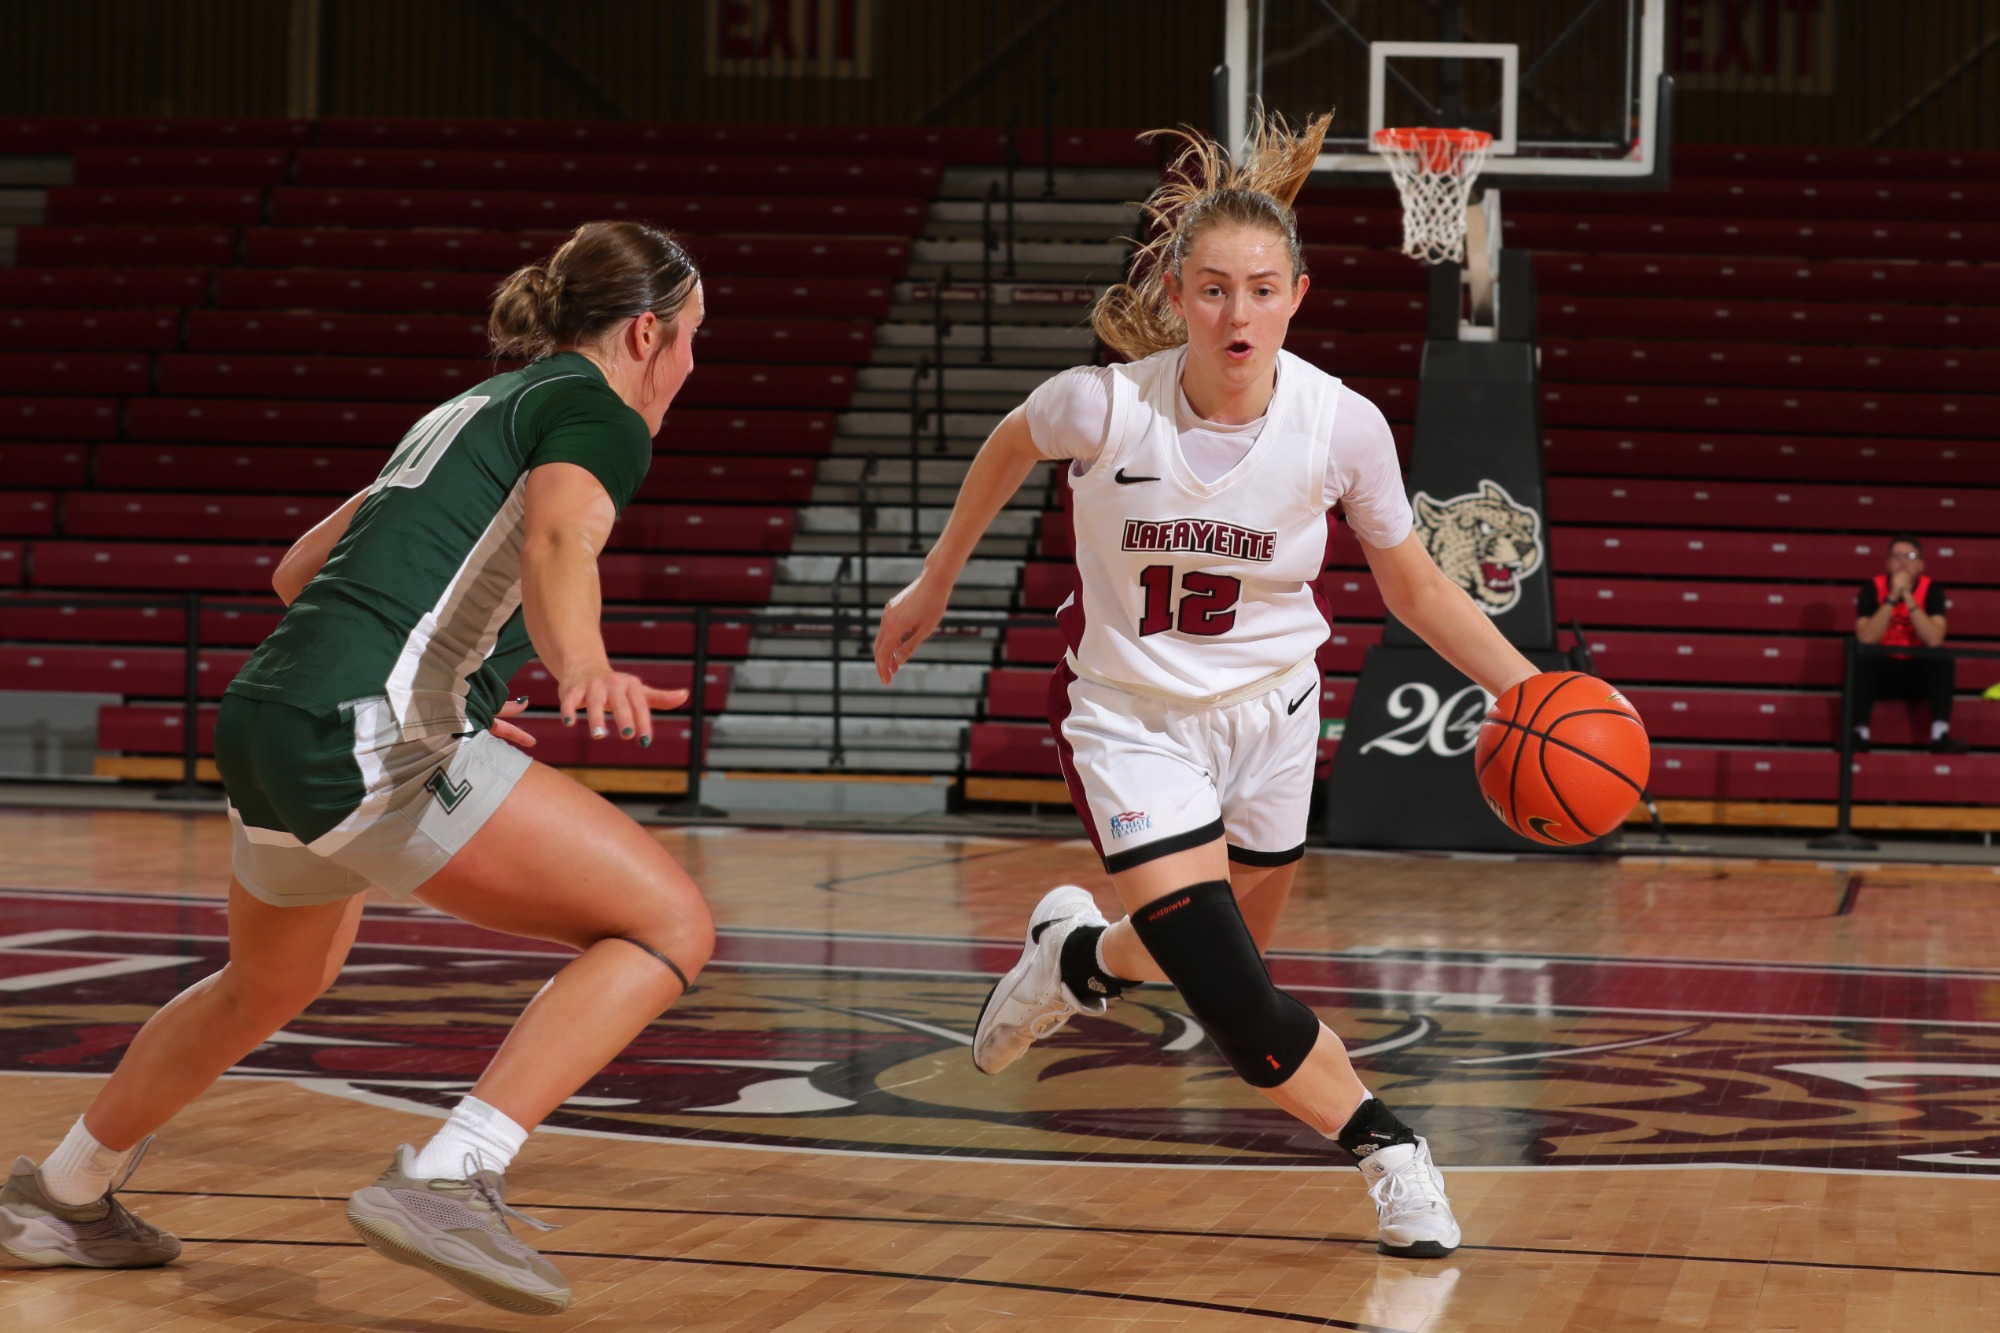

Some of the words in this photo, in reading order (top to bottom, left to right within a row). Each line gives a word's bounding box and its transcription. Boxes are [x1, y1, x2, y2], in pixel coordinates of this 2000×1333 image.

[1671, 0, 1821, 75] EXIT
[1122, 519, 1278, 561] LAFAYETTE
[1139, 565, 1241, 637] 12
